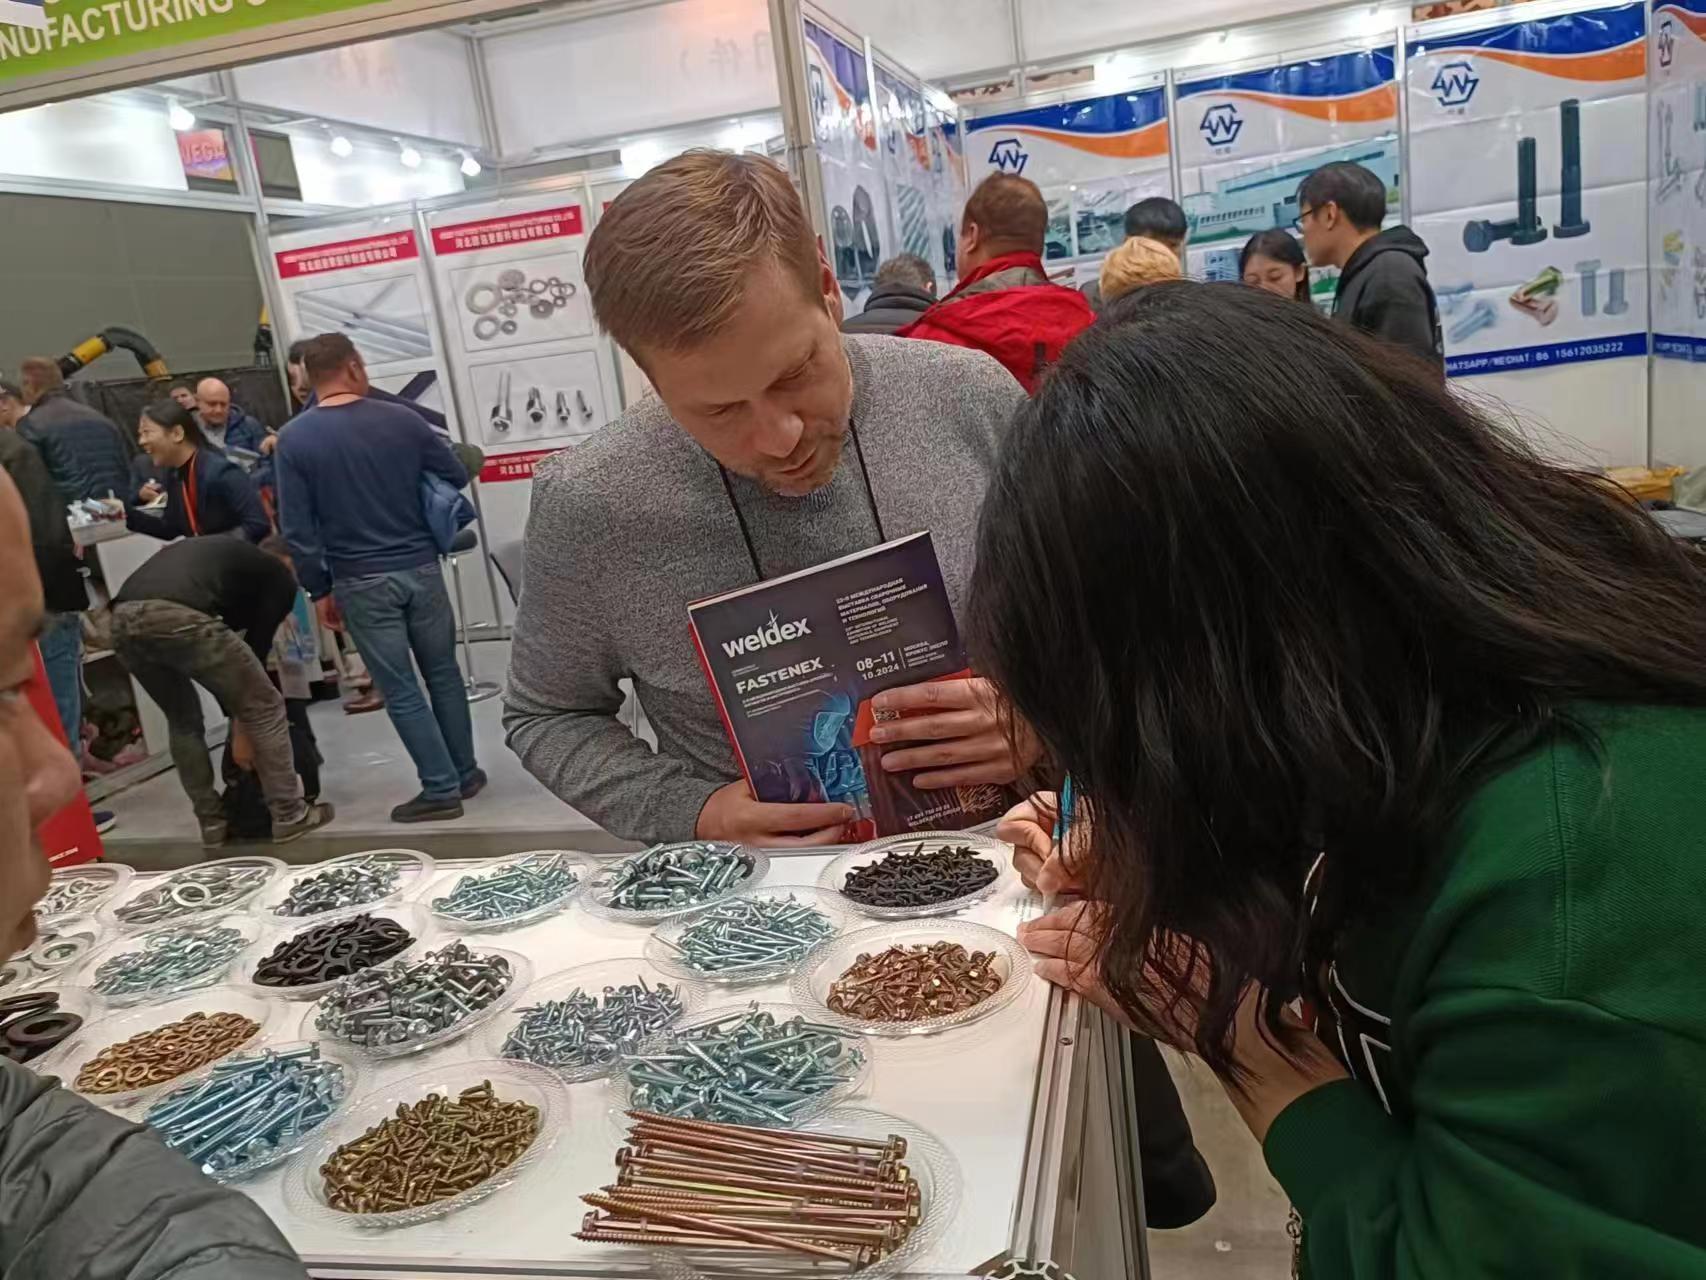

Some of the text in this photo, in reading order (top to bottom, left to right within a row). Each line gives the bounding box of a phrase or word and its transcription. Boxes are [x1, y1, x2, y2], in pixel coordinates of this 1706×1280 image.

[721, 616, 812, 658] weldex
[735, 656, 824, 695] FASTENEX
[862, 663, 900, 681] 10.2024
